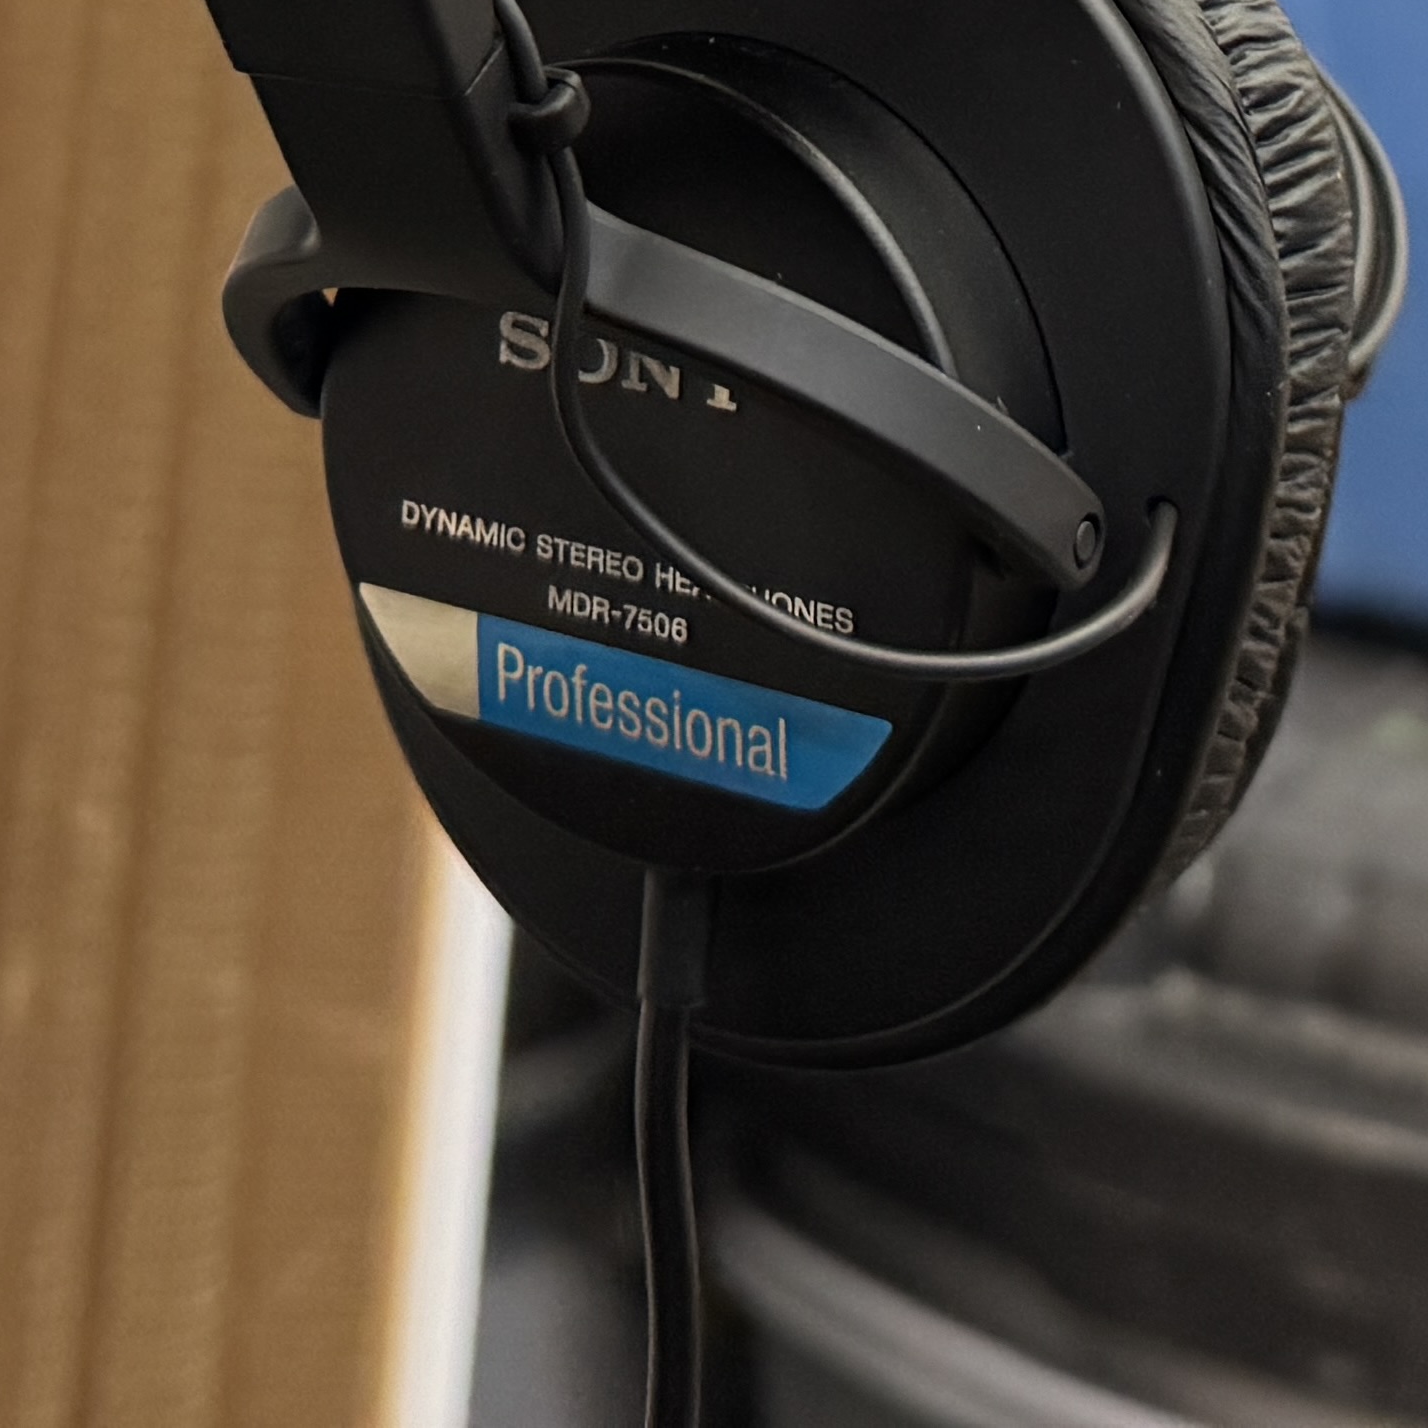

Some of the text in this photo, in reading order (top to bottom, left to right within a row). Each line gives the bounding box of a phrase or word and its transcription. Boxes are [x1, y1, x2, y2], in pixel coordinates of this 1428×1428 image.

[401, 498, 855, 635] DYNAMIC STEREO HEONES
[548, 584, 689, 643] MDR-7506
[496, 641, 789, 780] Professional
